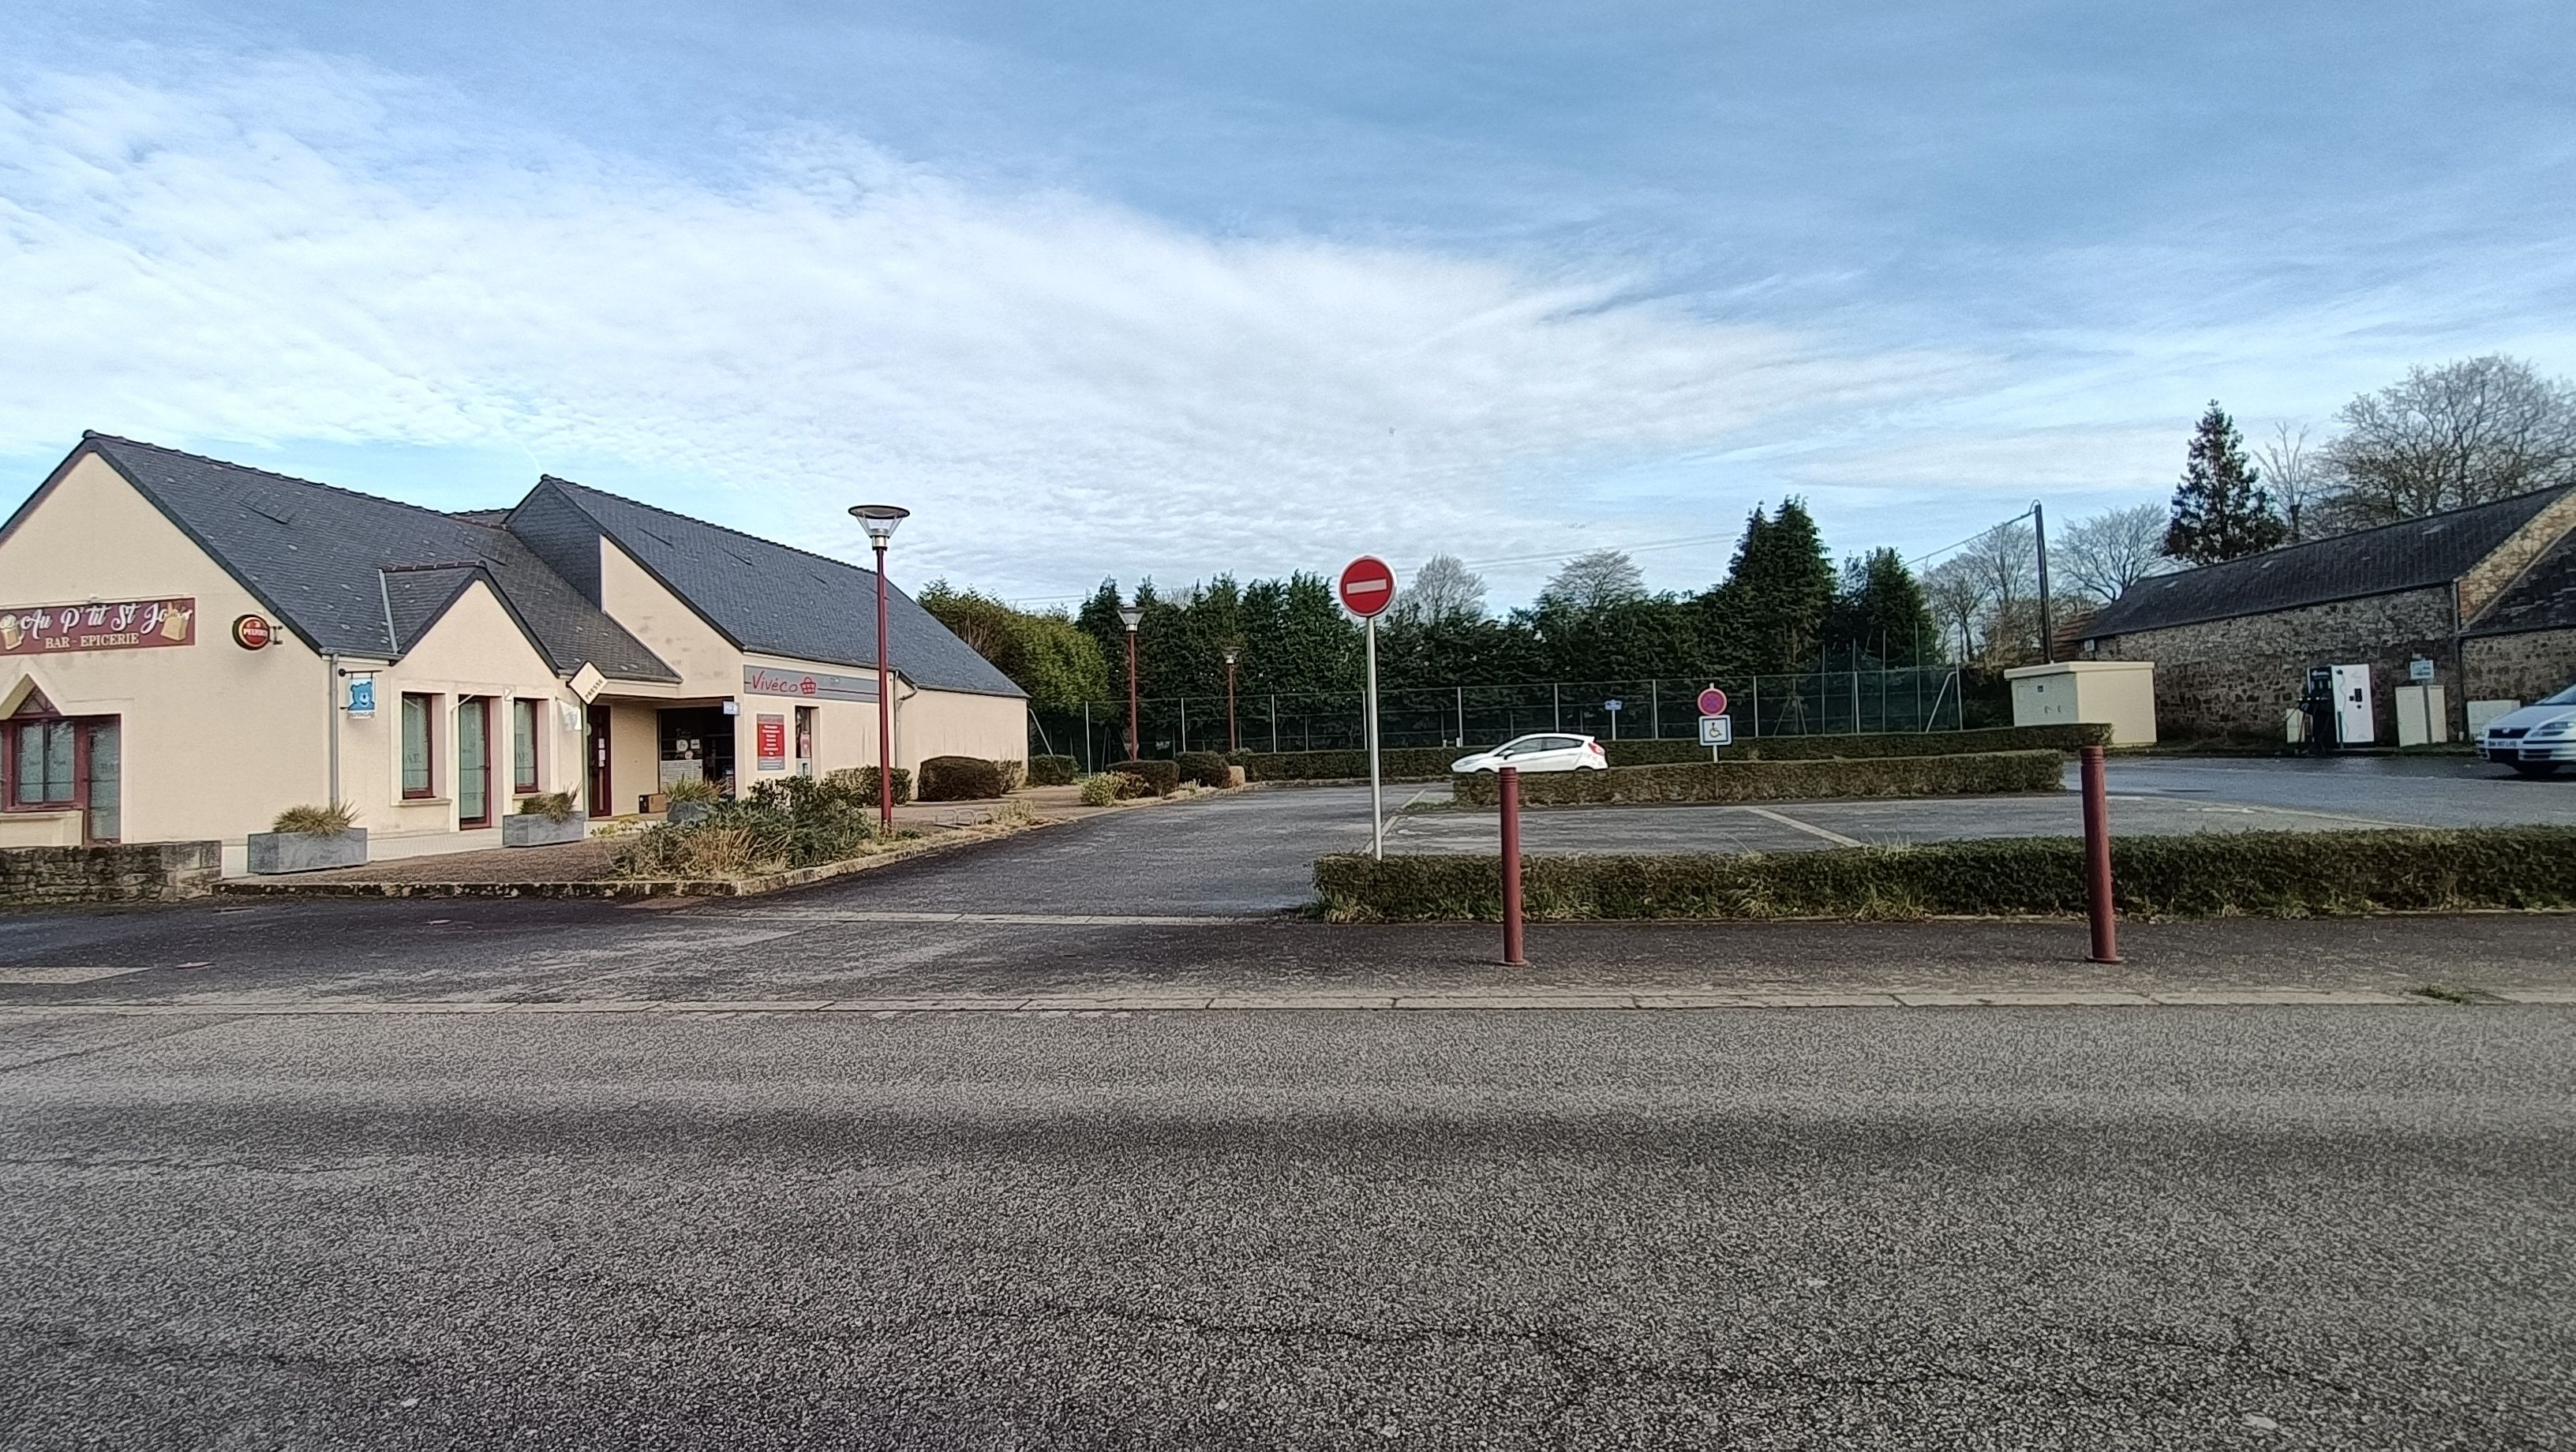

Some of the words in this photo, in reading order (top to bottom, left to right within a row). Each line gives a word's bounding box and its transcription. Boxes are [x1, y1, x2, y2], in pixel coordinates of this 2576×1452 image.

[21, 608, 53, 640] Au
[61, 604, 111, 634] P'tit
[110, 603, 142, 631] St
[45, 637, 70, 649] BAR
[80, 632, 140, 648] EPICERIE
[585, 679, 603, 700] PRESSE
[752, 671, 798, 693] Vivéco
